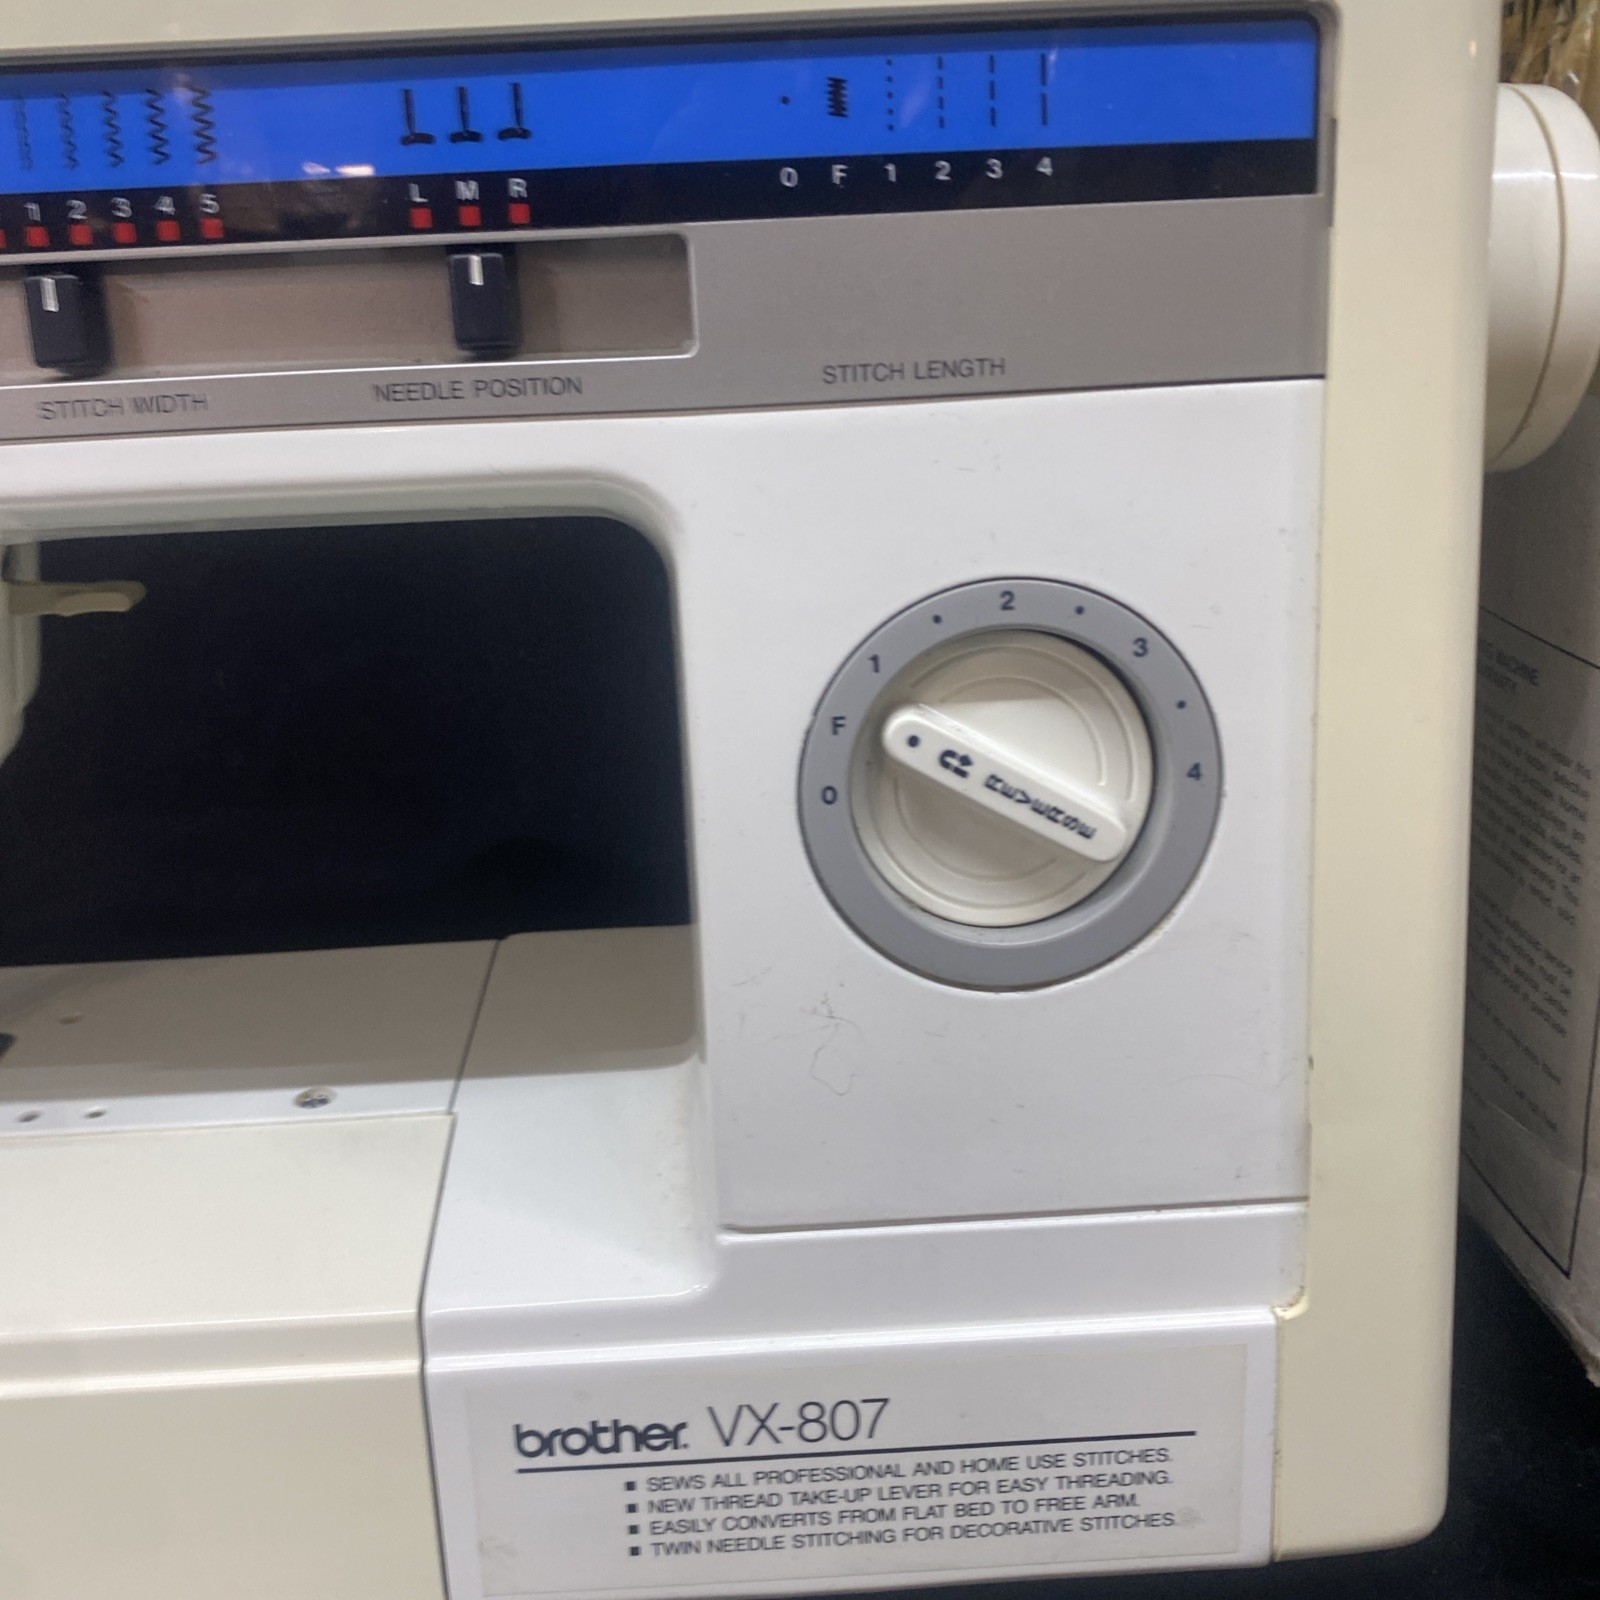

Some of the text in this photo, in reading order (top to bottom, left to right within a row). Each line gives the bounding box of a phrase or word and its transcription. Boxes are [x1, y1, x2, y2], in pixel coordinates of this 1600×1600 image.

[831, 164, 848, 185] F
[884, 163, 897, 182] 1
[934, 160, 951, 181] 2
[985, 158, 1003, 179] 3
[1036, 156, 1053, 177] 4
[23, 193, 220, 221] 1 2 3 4 5
[408, 178, 527, 202] L M R
[373, 376, 583, 402] NEEDLE POSITION
[821, 357, 1007, 384] STITCH LENGTH
[38, 393, 209, 420] STITCH WIDTH
[831, 715, 847, 734] F
[869, 655, 881, 673] 1
[1000, 590, 1016, 610] 2
[1132, 637, 1148, 657] 3
[1186, 763, 1203, 781] 4
[985, 774, 1097, 840] REVERSE
[707, 1398, 890, 1447] VX-807
[646, 1474, 706, 1492] SEWS
[710, 1472, 749, 1489] ALL
[753, 1463, 904, 1486] PROFESSIONAL
[912, 1460, 955, 1477] AND
[960, 1456, 1020, 1474] HOME
[1026, 1453, 1067, 1470] USE
[648, 1498, 695, 1514] NEW
[703, 1492, 783, 1511] THREAD
[789, 1487, 872, 1507] TAKE-UP
[877, 1483, 942, 1501] LEVER
[949, 1480, 990, 1497] FOR
[996, 1476, 1049, 1494] EASY
[650, 1517, 717, 1535] EASILY
[722, 1511, 832, 1531] CONVERTS
[838, 1506, 896, 1526] FROM
[902, 1504, 948, 1521] FLAT
[954, 1501, 996, 1518] BED
[1002, 1498, 1029, 1515] TO
[1035, 1495, 1087, 1513] FREE
[651, 1540, 701, 1557] TWIN
[707, 1535, 786, 1553] NEEDLE
[792, 1529, 896, 1550] STITCHING
[902, 1526, 944, 1543] FOR
[951, 1518, 1074, 1541] DECORATIVE
